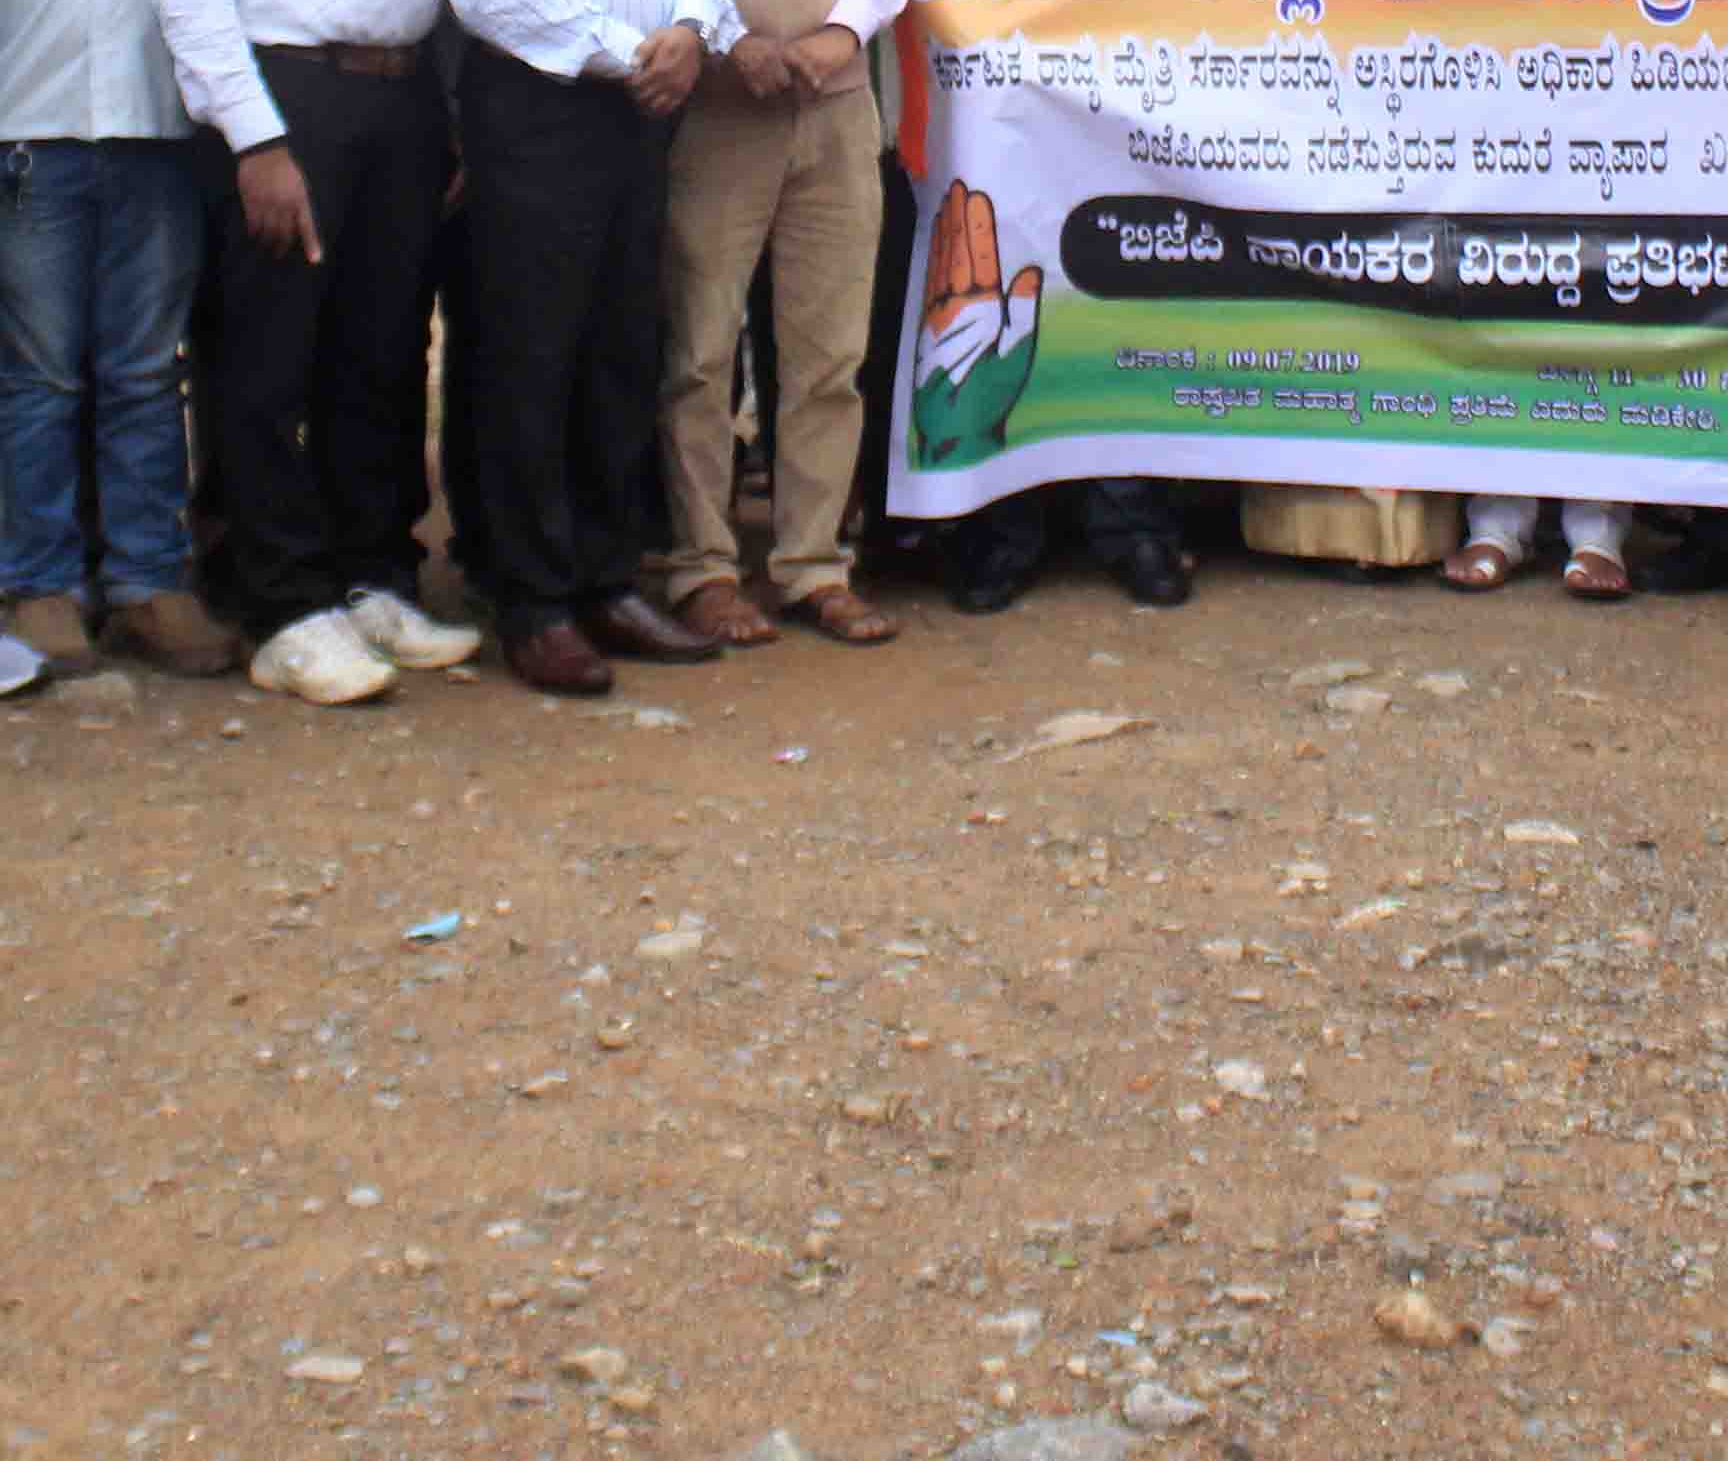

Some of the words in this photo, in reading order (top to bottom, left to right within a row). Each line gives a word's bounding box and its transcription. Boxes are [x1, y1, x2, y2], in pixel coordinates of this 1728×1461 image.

[1114, 42, 1177, 113] ಮೈತ್ರಿ
[1189, 45, 1342, 116] ಸರ್ಕಾರವನ್ನು
[1517, 46, 1614, 100] ಅಧಿಕಾರ
[1128, 124, 1290, 171] ಬಿಜೆಪಿಯವರು
[1306, 126, 1457, 194] ನಡೆಸುತ್ತಿರುವ
[1472, 127, 1553, 174] ಕುದುರೆ
[1568, 131, 1668, 200] ವ್ಯಾಪಾರ
[1246, 231, 1435, 284] ನಾಯಕರ
